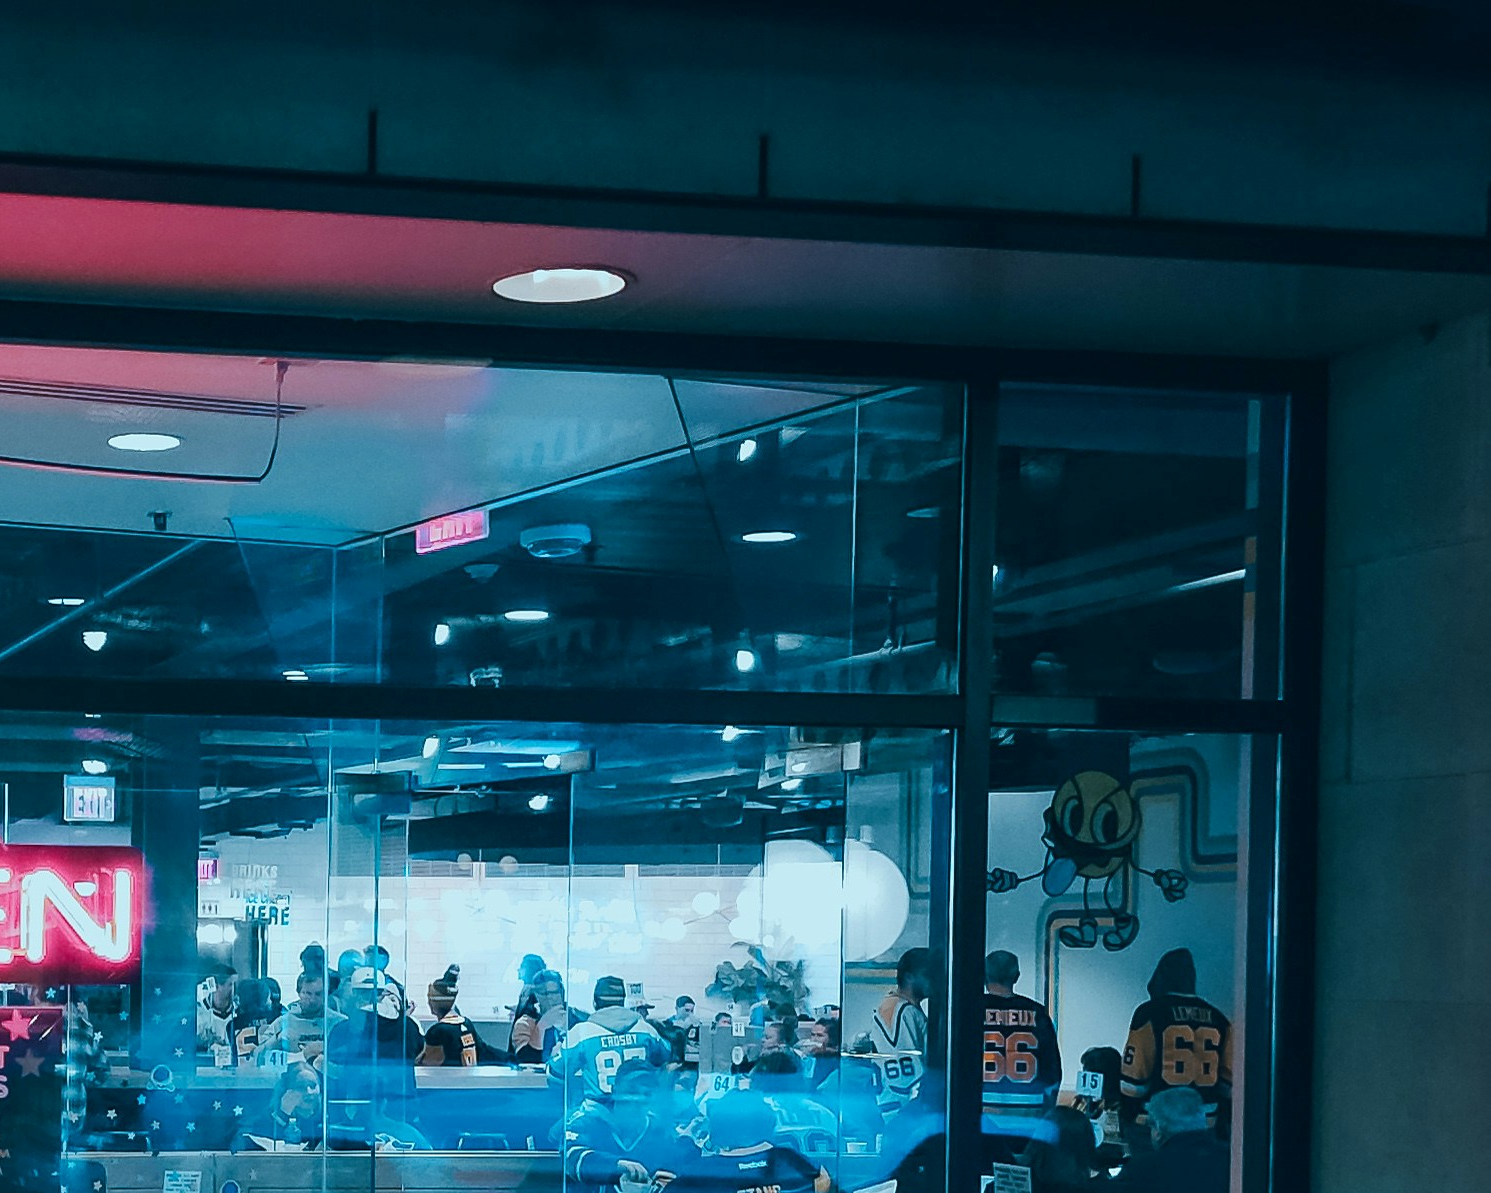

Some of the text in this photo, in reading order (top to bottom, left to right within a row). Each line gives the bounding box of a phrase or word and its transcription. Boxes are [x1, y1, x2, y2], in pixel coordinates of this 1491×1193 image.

[245, 905, 289, 925] HERE
[984, 1009, 1036, 1027] EMIEUX
[601, 1034, 637, 1048] CROSBY
[983, 1032, 1038, 1083] 66
[1162, 1025, 1220, 1087] 66
[884, 1056, 914, 1079] 66
[713, 1076, 729, 1091] 64
[1081, 1073, 1098, 1089] 15
